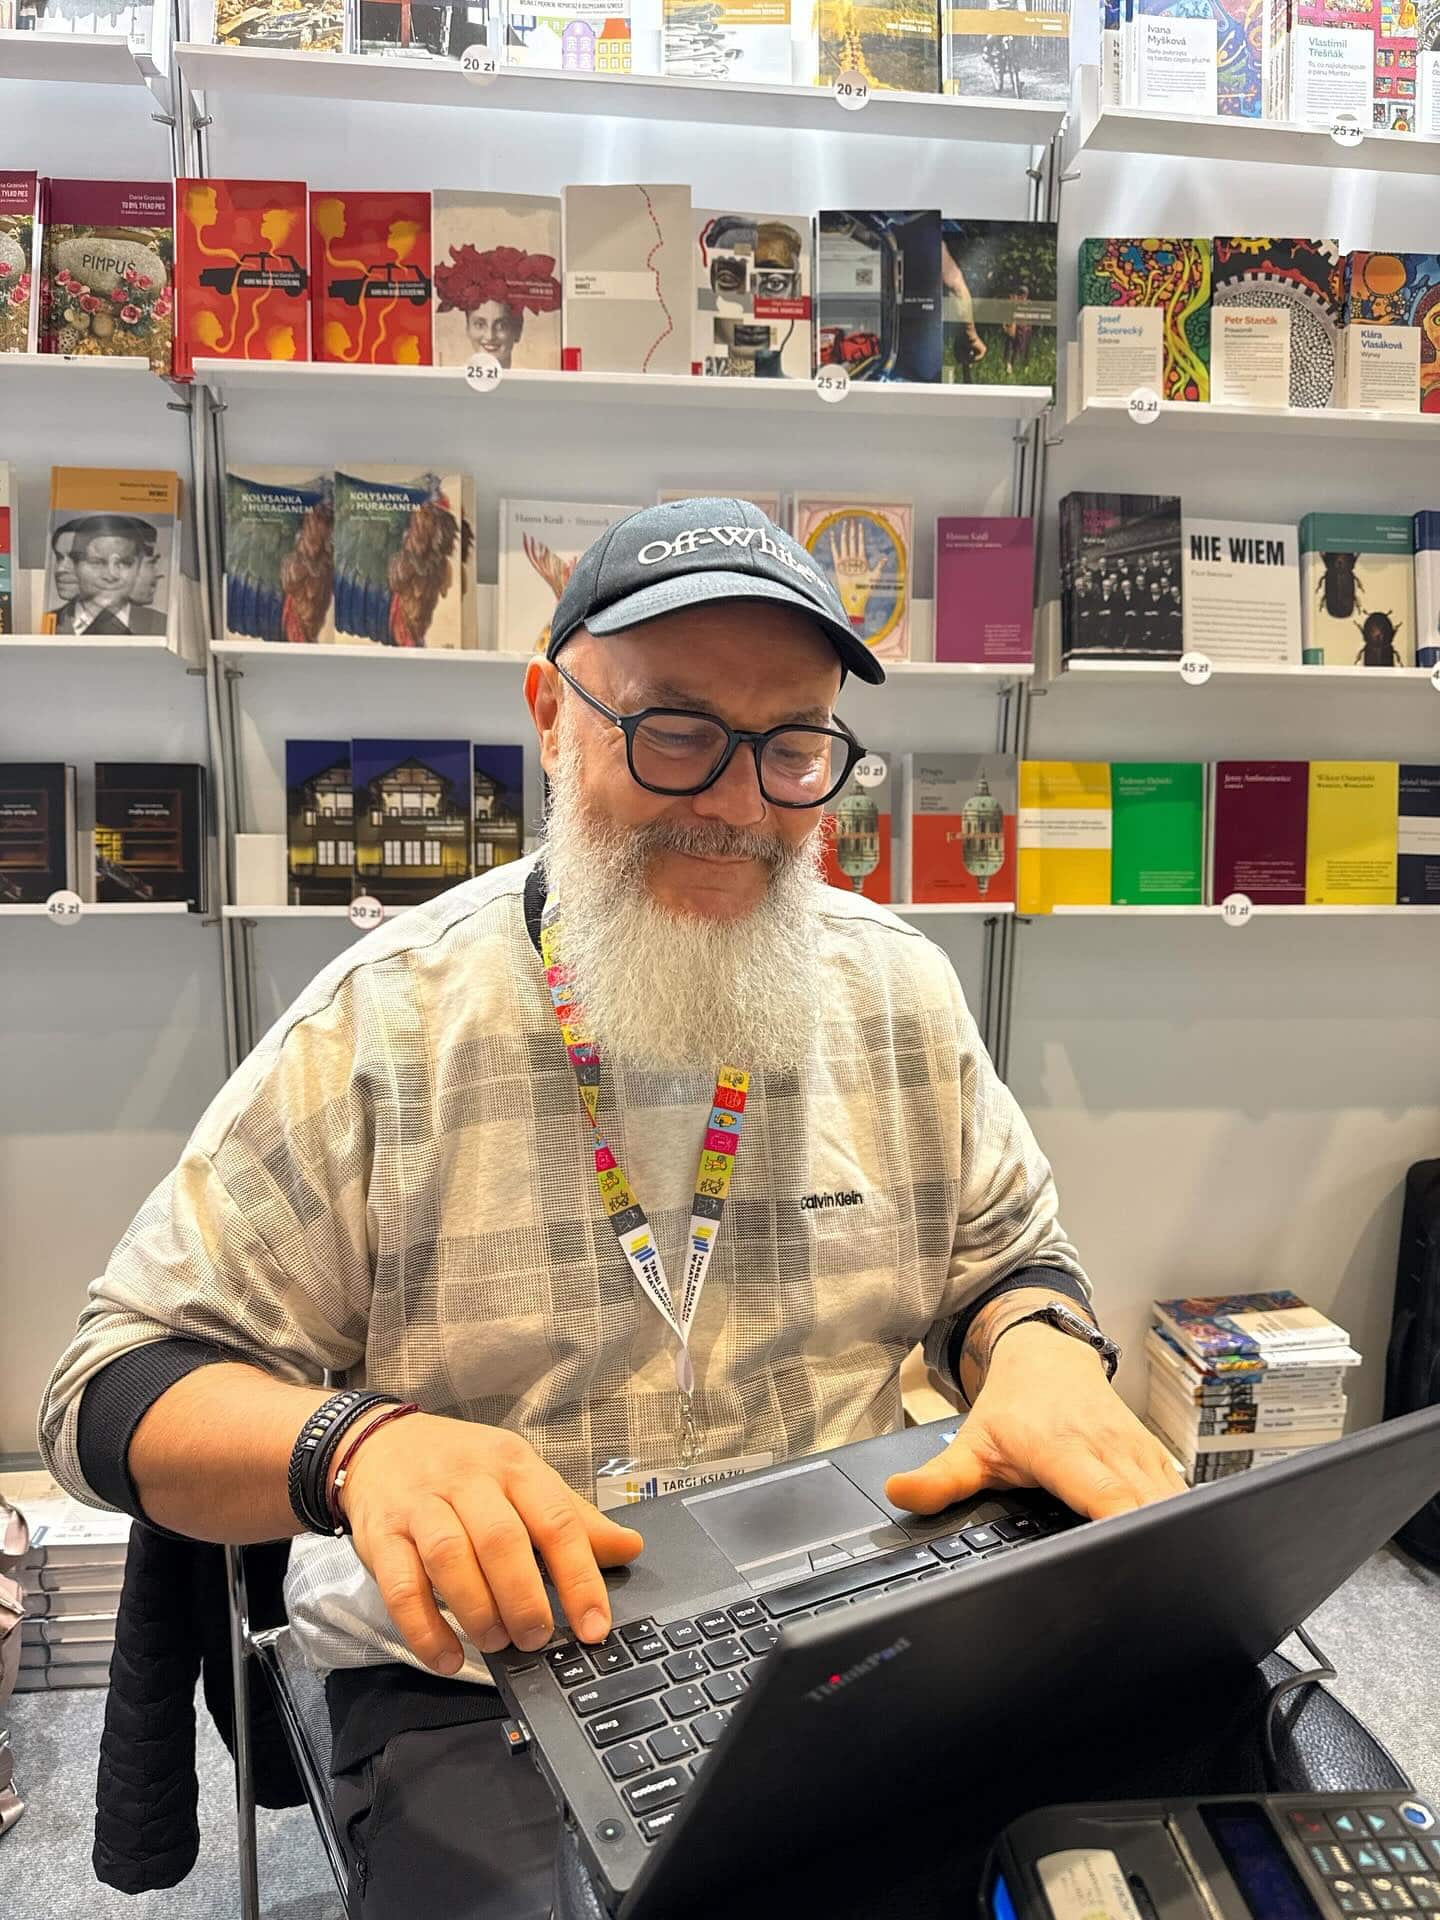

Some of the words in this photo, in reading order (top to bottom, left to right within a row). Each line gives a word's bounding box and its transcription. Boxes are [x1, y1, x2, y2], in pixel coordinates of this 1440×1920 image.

[1147, 24, 1171, 34] Ivana
[1147, 35, 1187, 46] Myšková
[1308, 37, 1348, 48] Vlastimil
[463, 58, 480, 71] 20
[484, 60, 495, 72] zł
[836, 83, 852, 95] 20
[856, 85, 867, 97] zł
[1333, 125, 1346, 135] 25
[1350, 126, 1360, 137] zł
[82, 254, 137, 275] PIMPUS
[1225, 315, 1242, 325] Petr
[1245, 315, 1278, 326] Stančík
[1361, 330, 1383, 341] Klára
[1361, 340, 1403, 351] Vlasáková
[467, 367, 483, 378] 25
[487, 368, 498, 379] zł
[817, 378, 833, 389] 25
[836, 378, 847, 390] zł
[1130, 400, 1144, 411] 50
[1146, 400, 1158, 412] zł
[241, 493, 303, 504] KOŁYSANKA
[350, 492, 410, 502] KOŁYSANKA
[248, 503, 314, 515] HURAGANEM
[356, 502, 421, 512] HURAGANEM
[638, 526, 818, 584] Off-White
[1190, 535, 1221, 562] NIE
[1228, 537, 1285, 566] WIEM
[1181, 663, 1197, 672] 45
[1198, 662, 1209, 673] zł
[856, 765, 870, 776] 30
[873, 765, 884, 776] zł
[48, 904, 64, 914] 45
[68, 904, 80, 914] zł
[351, 906, 366, 918] 30
[369, 907, 381, 918] zł
[1225, 905, 1236, 916] 10
[1239, 905, 1249, 916] zł
[692, 1254, 698, 1263] W
[642, 1264, 650, 1273] W
[648, 1259, 662, 1287] TARGI
[694, 1255, 704, 1283] TARGI
[663, 1478, 695, 1492] TARGI
[676, 1627, 692, 1638] Ctrl
[577, 1691, 599, 1702] Shift
[596, 1719, 619, 1731] Enter
[631, 1778, 677, 1798] Backspace
